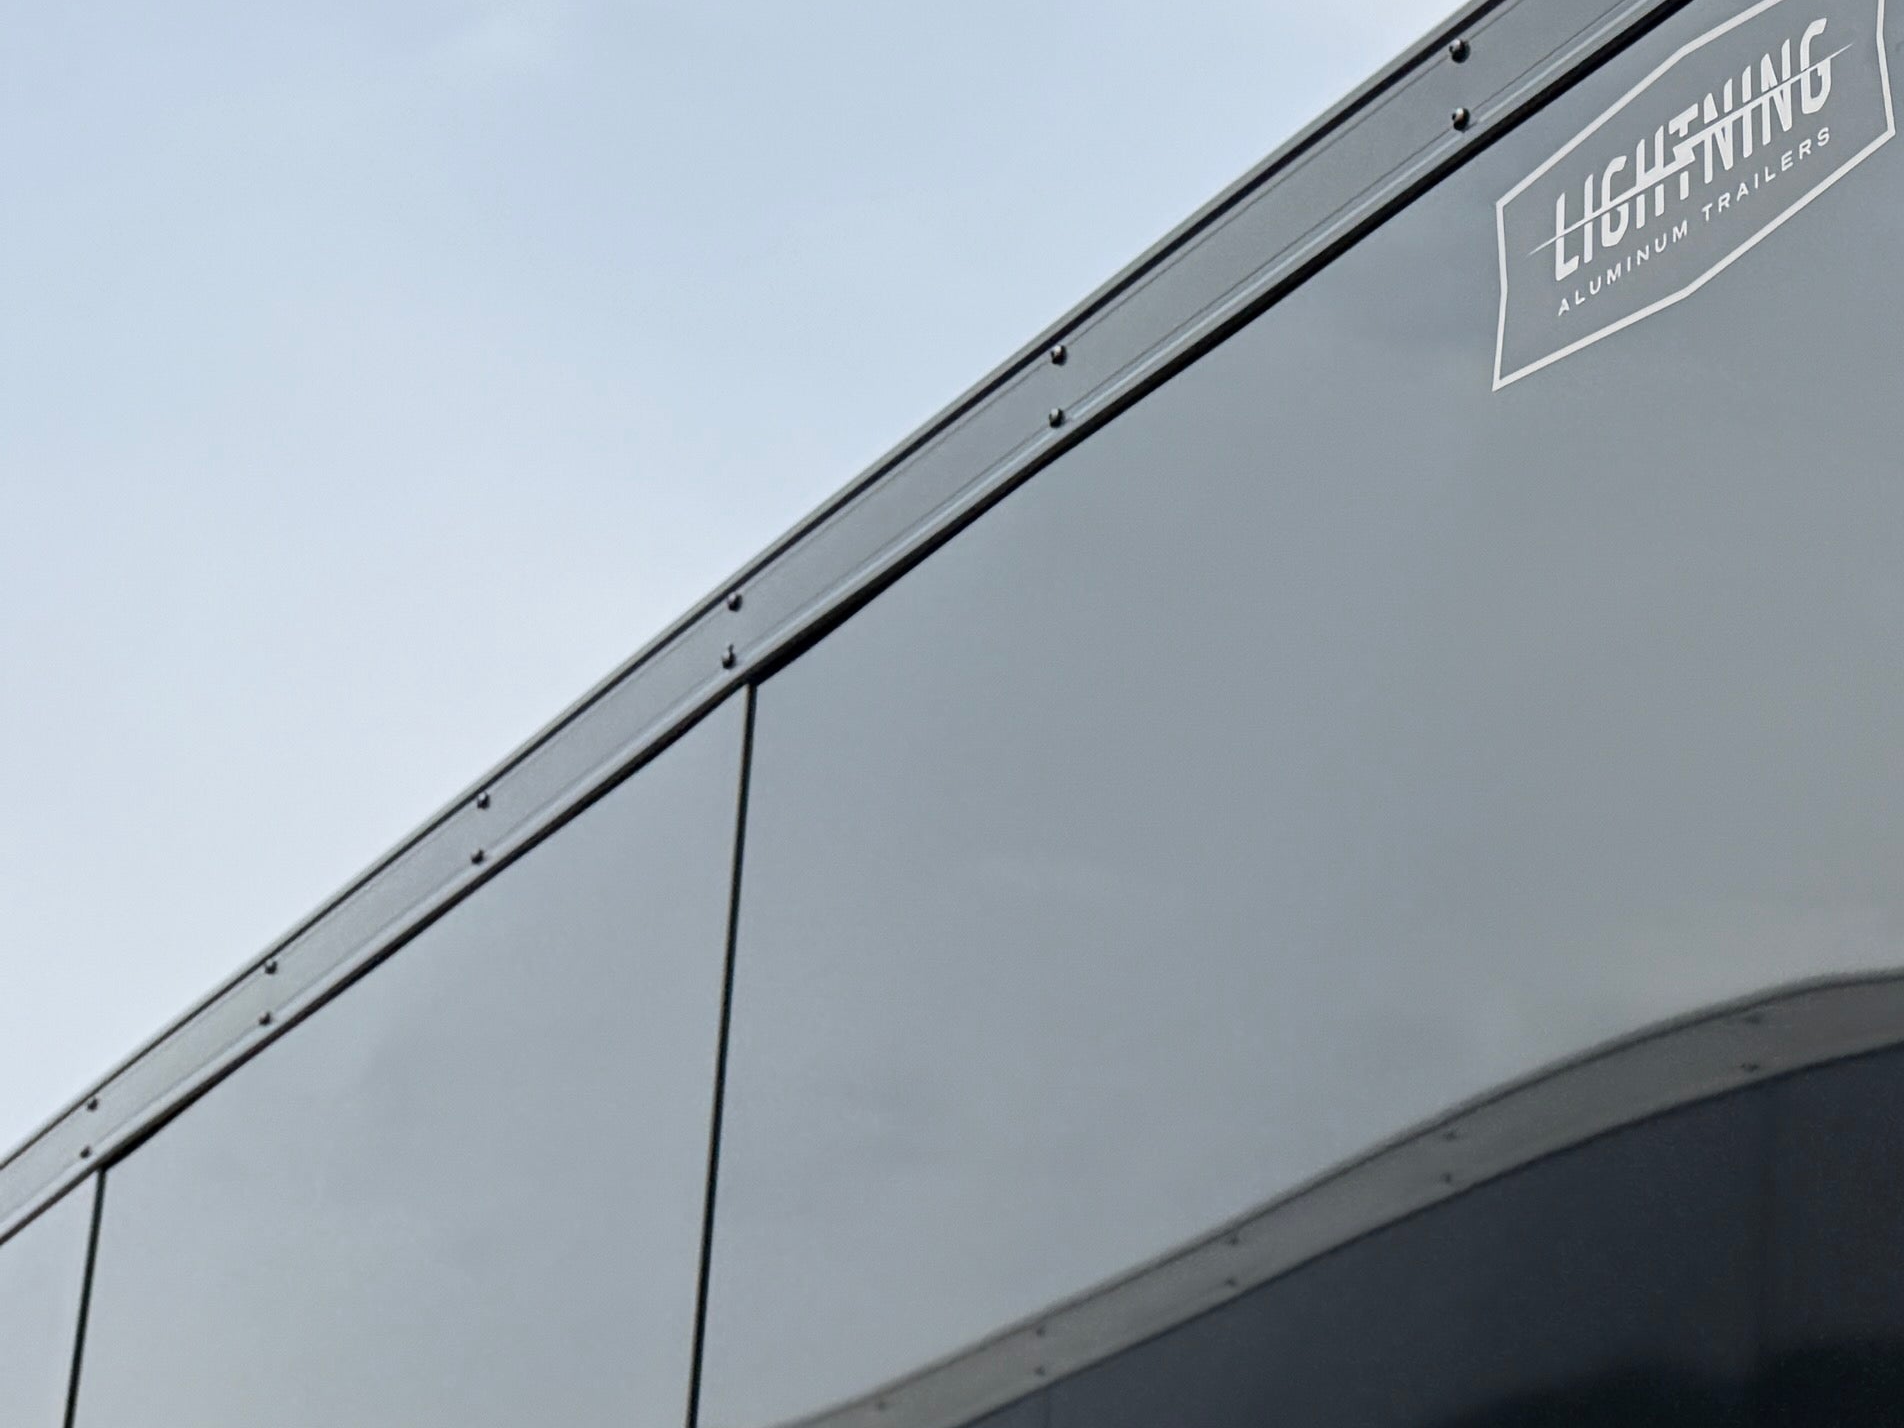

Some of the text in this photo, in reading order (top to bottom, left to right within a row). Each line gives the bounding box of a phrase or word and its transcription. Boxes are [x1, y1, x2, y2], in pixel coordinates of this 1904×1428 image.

[1555, 17, 1832, 282] LIGHTNING
[1557, 126, 1831, 317] ALUMINUM TRAILERS
